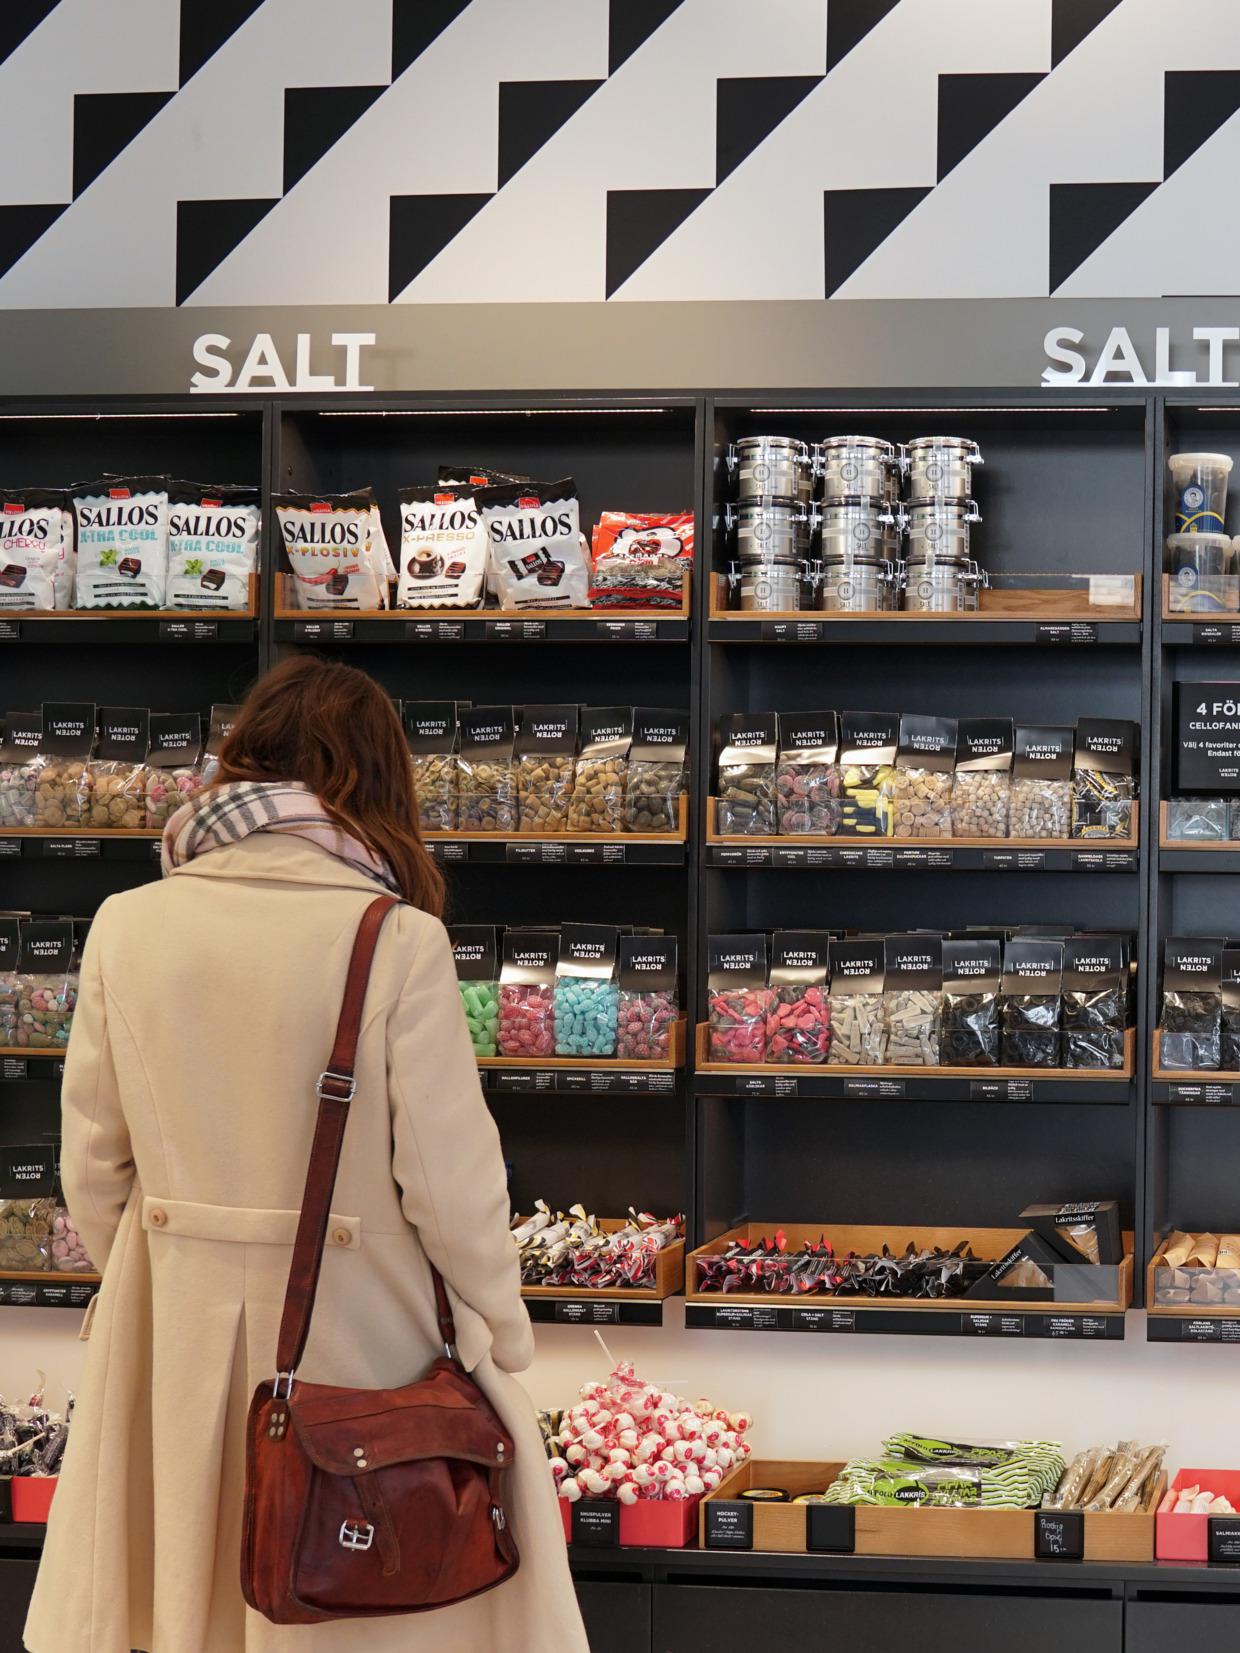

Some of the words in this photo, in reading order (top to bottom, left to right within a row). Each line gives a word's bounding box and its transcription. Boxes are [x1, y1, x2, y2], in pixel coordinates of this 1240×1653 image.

[1042, 327, 1240, 386] SALT
[191, 334, 376, 392] SALT
[79, 504, 159, 528] SALLOS
[404, 510, 478, 533] SALLOS
[169, 515, 247, 538] SALLOS
[490, 513, 572, 543] SALLOS
[118, 528, 158, 542] COOL
[283, 520, 359, 545] SALLOS
[205, 541, 244, 554] COOL
[1196, 703, 1207, 715] 4
[52, 721, 85, 730] LAKRITS
[470, 725, 503, 735] LAKRITS
[55, 729, 81, 737] ROTEN
[108, 726, 139, 735] LAKRITS
[643, 727, 677, 736] LAKRITS
[110, 734, 136, 742] ROTEN
[474, 733, 501, 742] ROTEN
[646, 734, 673, 743] ROTEN
[853, 731, 887, 740] LAKRITS
[855, 739, 883, 747] ROTEN
[1087, 736, 1122, 745] LAKRITS
[1090, 744, 1118, 752] ROTEN
[1183, 741, 1197, 750] Välj
[1205, 741, 1237, 749] favoriter
[33, 948, 59, 956] ROTEN
[783, 951, 817, 959] LAKRITS
[632, 955, 665, 963] LAKRITS
[786, 958, 813, 966] ROTEN
[954, 959, 989, 968] LAKRITS
[634, 963, 662, 971] ROTEN
[957, 967, 986, 976] ROTEN
[15, 1172, 41, 1180] ROTEN
[1055, 1214, 1094, 1224] Lakritsskiffer
